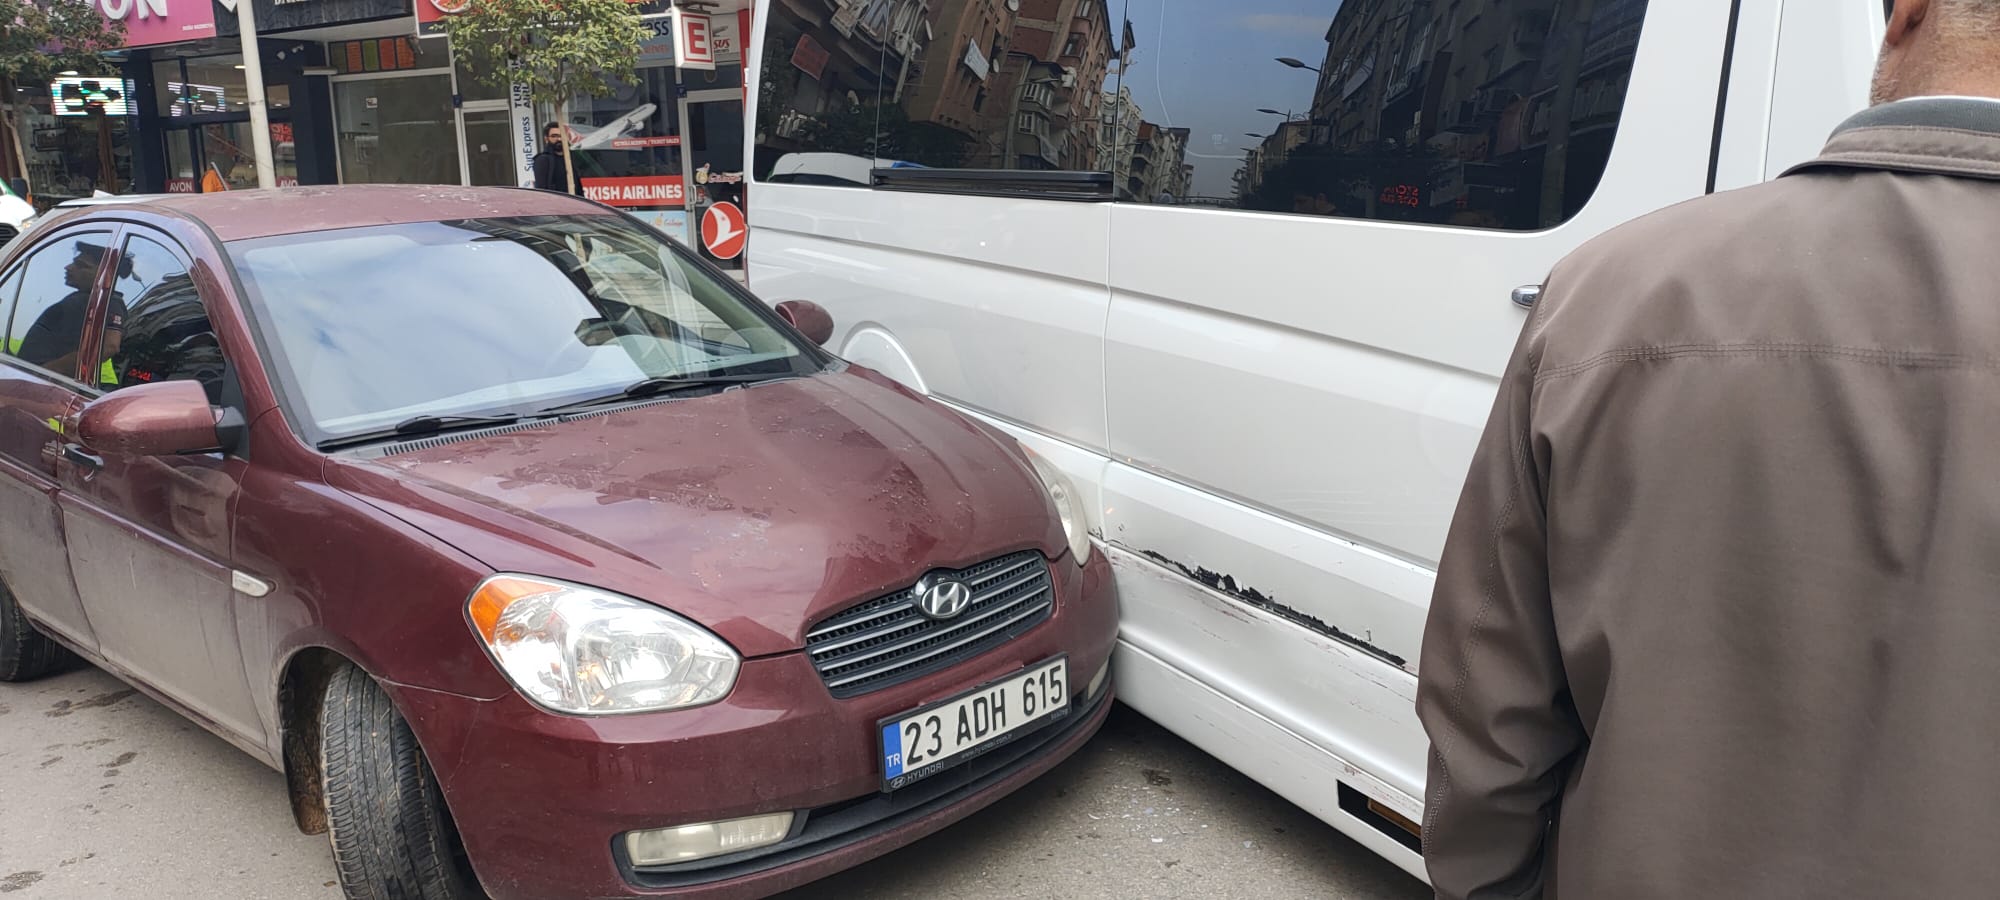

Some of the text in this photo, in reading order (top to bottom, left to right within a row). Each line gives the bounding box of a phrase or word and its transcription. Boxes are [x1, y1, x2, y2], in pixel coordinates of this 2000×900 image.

[169, 182, 193, 193] AVON
[622, 184, 682, 199] AIRLINES
[905, 715, 942, 766] 23
[956, 688, 1006, 746] ADH
[1022, 665, 1062, 717] 615
[887, 754, 901, 768] TR
[906, 762, 944, 782] HYUNDAI
